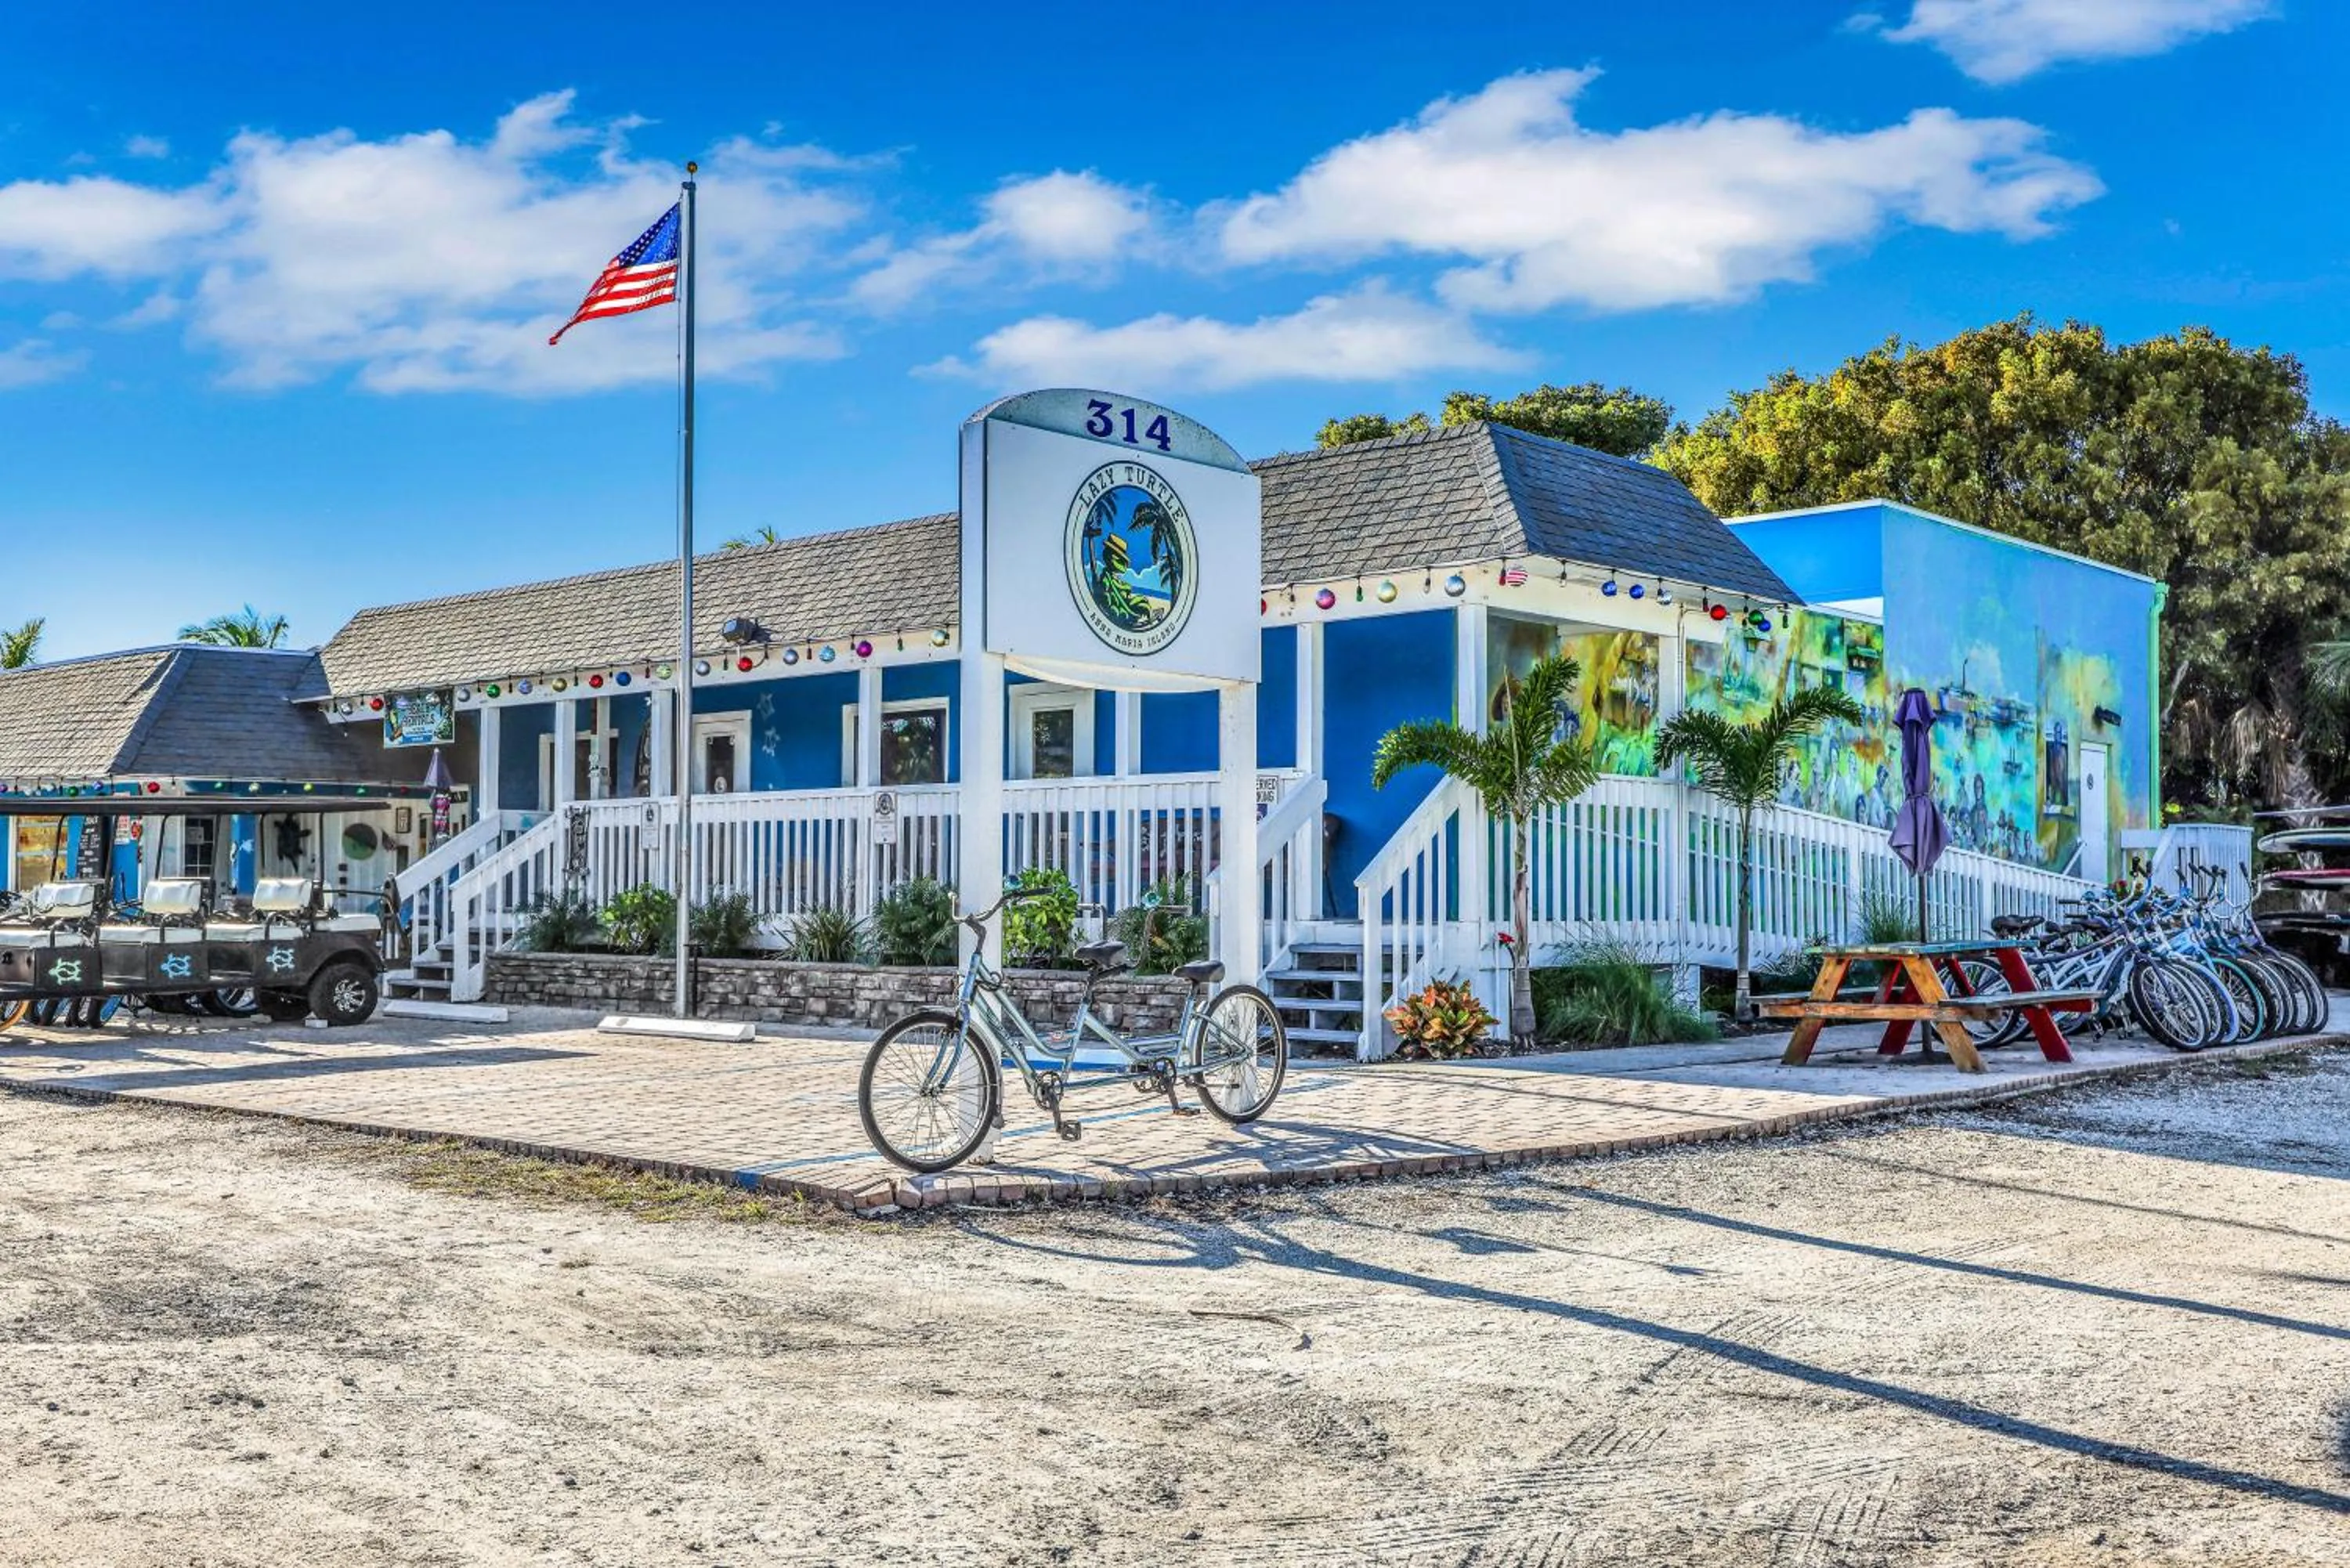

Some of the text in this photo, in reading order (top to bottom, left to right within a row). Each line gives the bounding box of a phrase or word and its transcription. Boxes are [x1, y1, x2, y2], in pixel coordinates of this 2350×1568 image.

[1086, 399, 1171, 452] 314
[1079, 466, 1184, 522] LAZY TURTLE
[1090, 612, 1176, 649] ANNA MARIA ISLAND
[1256, 778, 1276, 790] ERVED
